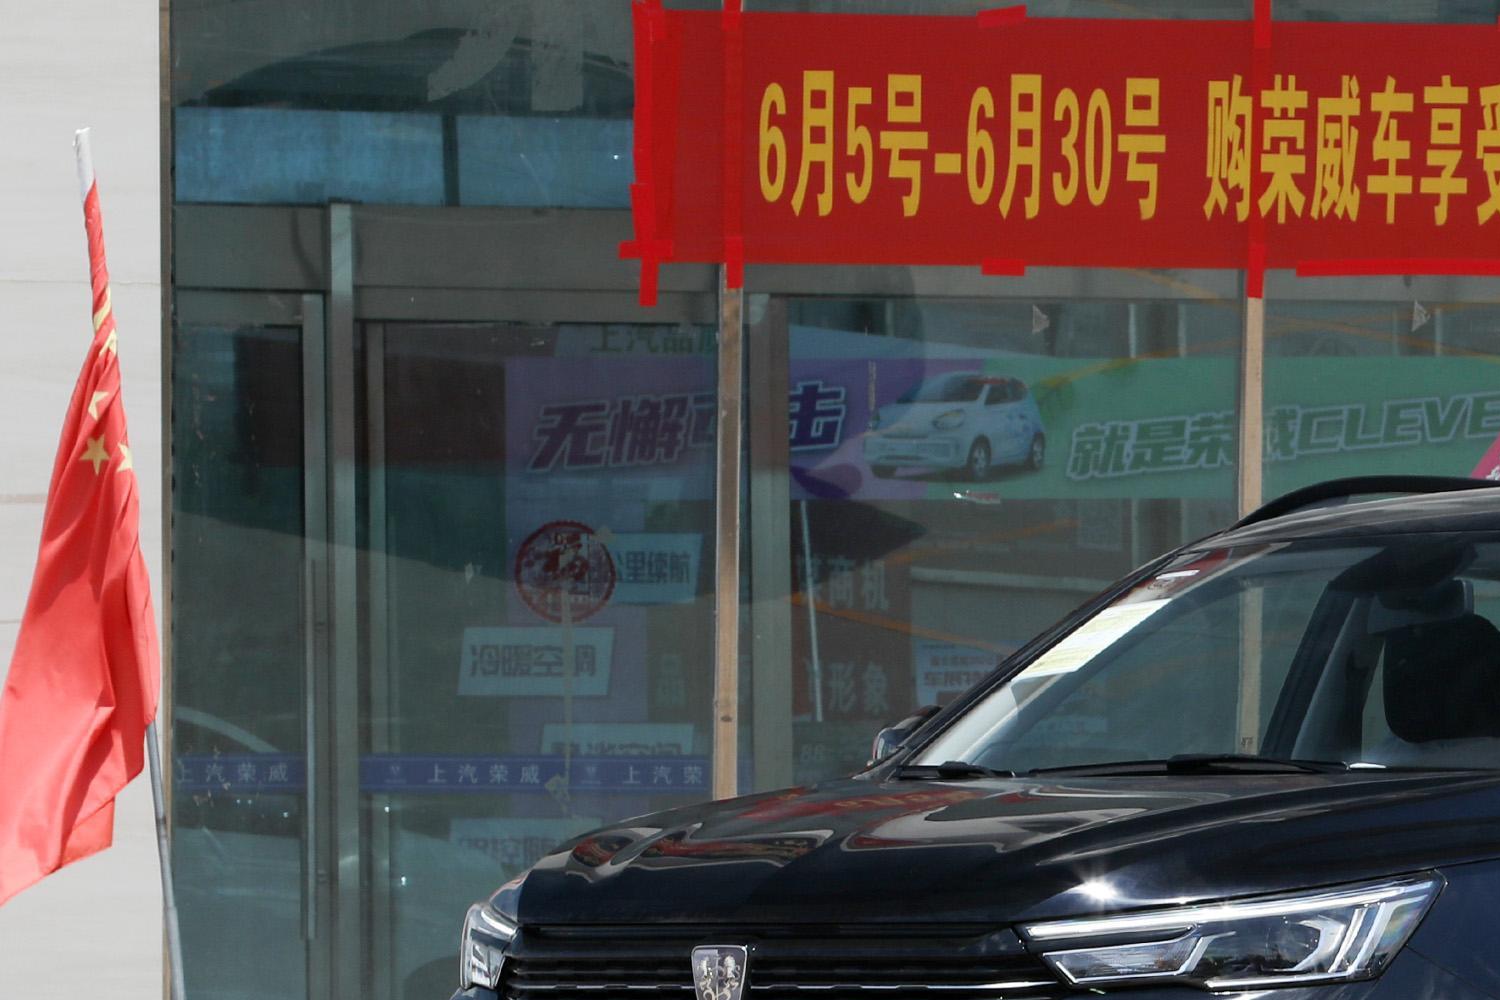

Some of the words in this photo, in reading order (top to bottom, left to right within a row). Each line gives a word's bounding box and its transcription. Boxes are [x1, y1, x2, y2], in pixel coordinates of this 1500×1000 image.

[758, 70, 1166, 221] 6月5号-6月30号
[427, 762, 541, 786] 上汽荣威
